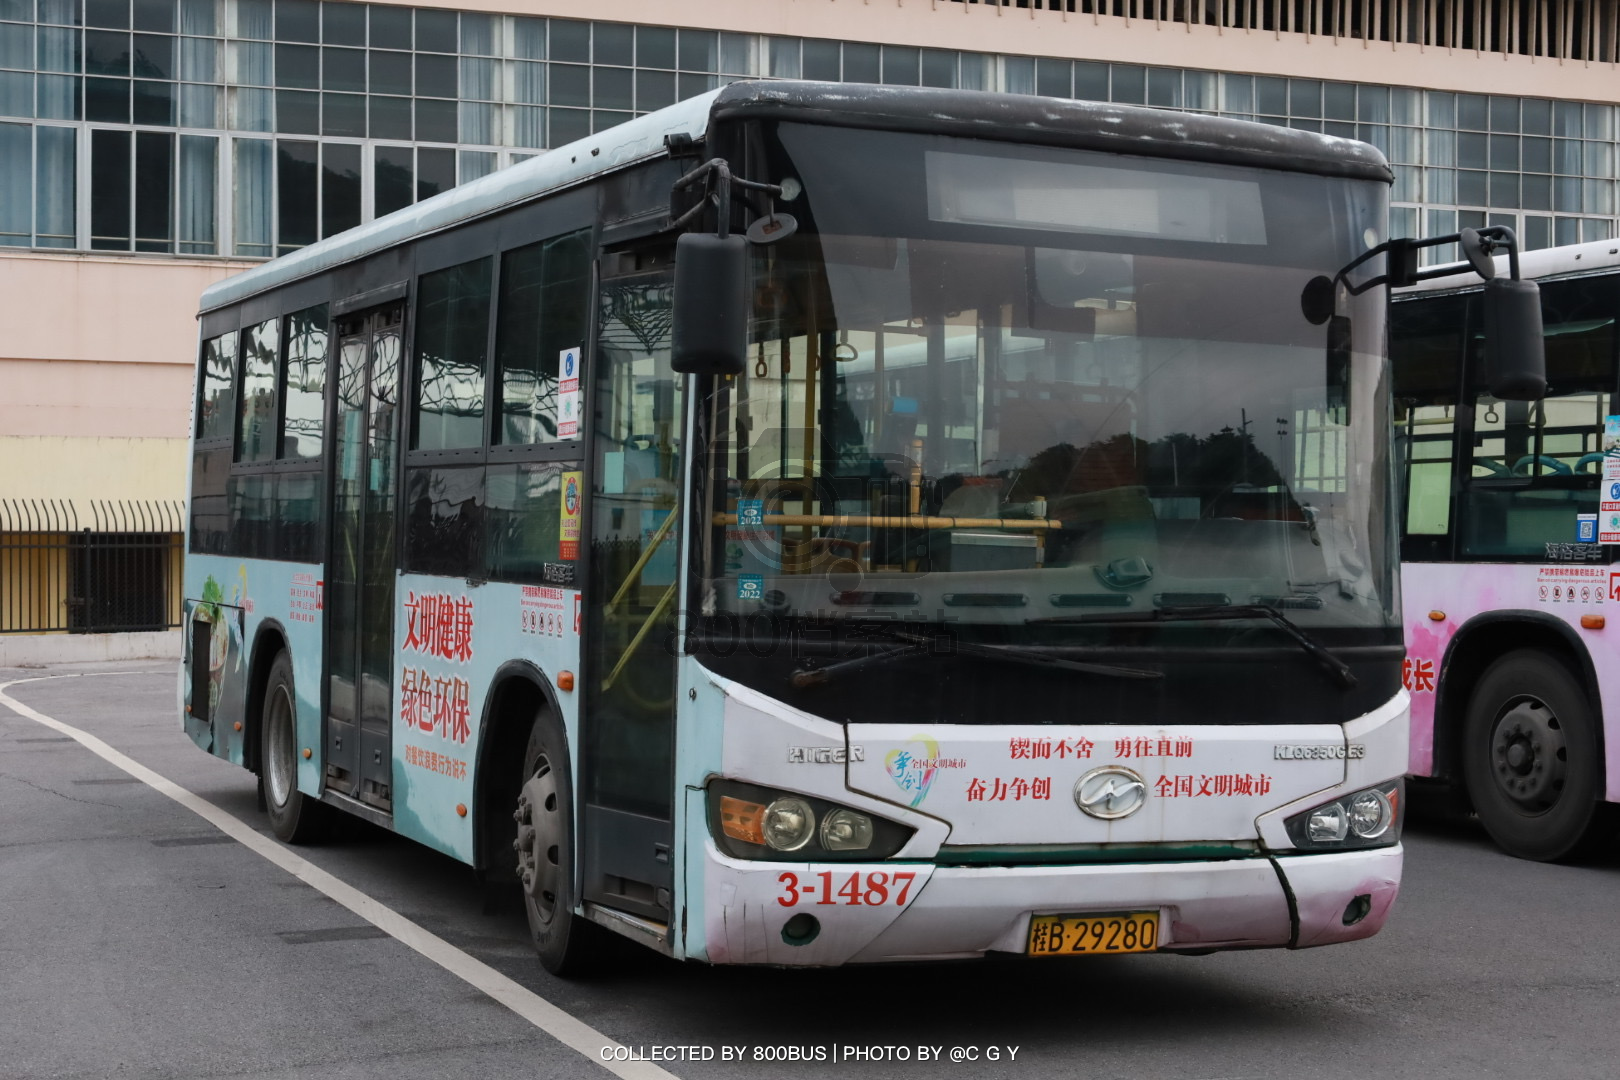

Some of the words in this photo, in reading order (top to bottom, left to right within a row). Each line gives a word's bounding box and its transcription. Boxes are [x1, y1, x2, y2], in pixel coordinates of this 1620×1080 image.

[740, 516, 762, 525] 2022
[739, 589, 761, 599] 2022
[402, 591, 474, 662] 文明健康
[400, 666, 471, 744] 绿色环保
[1009, 736, 1095, 760] 锲而不舍
[1114, 735, 1194, 758] 勇往直前
[911, 759, 968, 769] 全国文明城市
[965, 776, 1052, 802] 奋力争创
[1153, 773, 1273, 798] 全国文明城市
[777, 870, 917, 908] 3-1487
